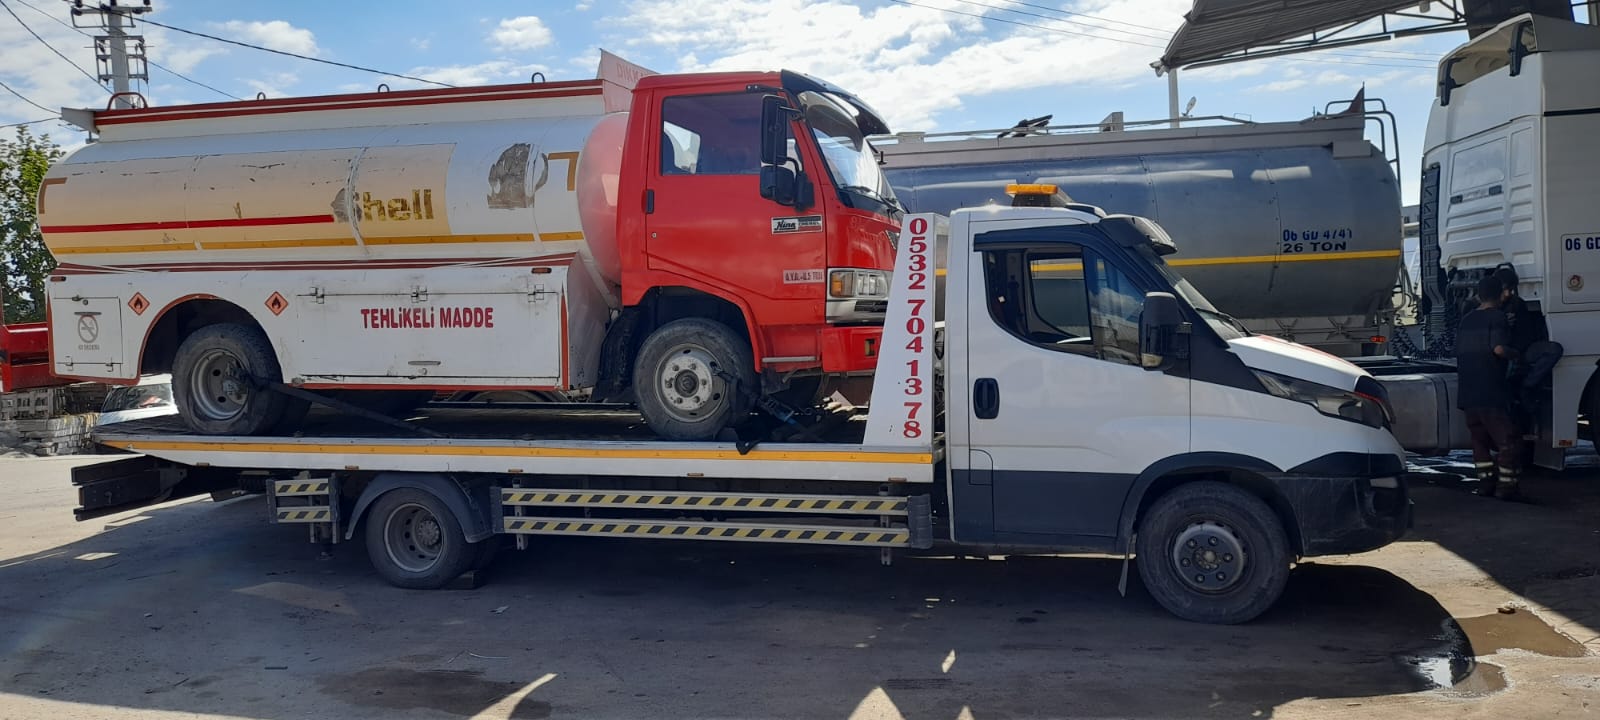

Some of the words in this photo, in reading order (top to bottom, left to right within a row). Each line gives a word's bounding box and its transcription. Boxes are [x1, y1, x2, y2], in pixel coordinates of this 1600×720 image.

[1283, 229, 1298, 241] 06
[1283, 243, 1304, 253] 26
[1310, 241, 1347, 252] TON
[1565, 237, 1581, 251] 06
[908, 218, 928, 290] 0532
[439, 307, 494, 329] MADDE
[905, 299, 926, 353] 704
[904, 360, 923, 396] 13
[903, 402, 923, 438] 78
